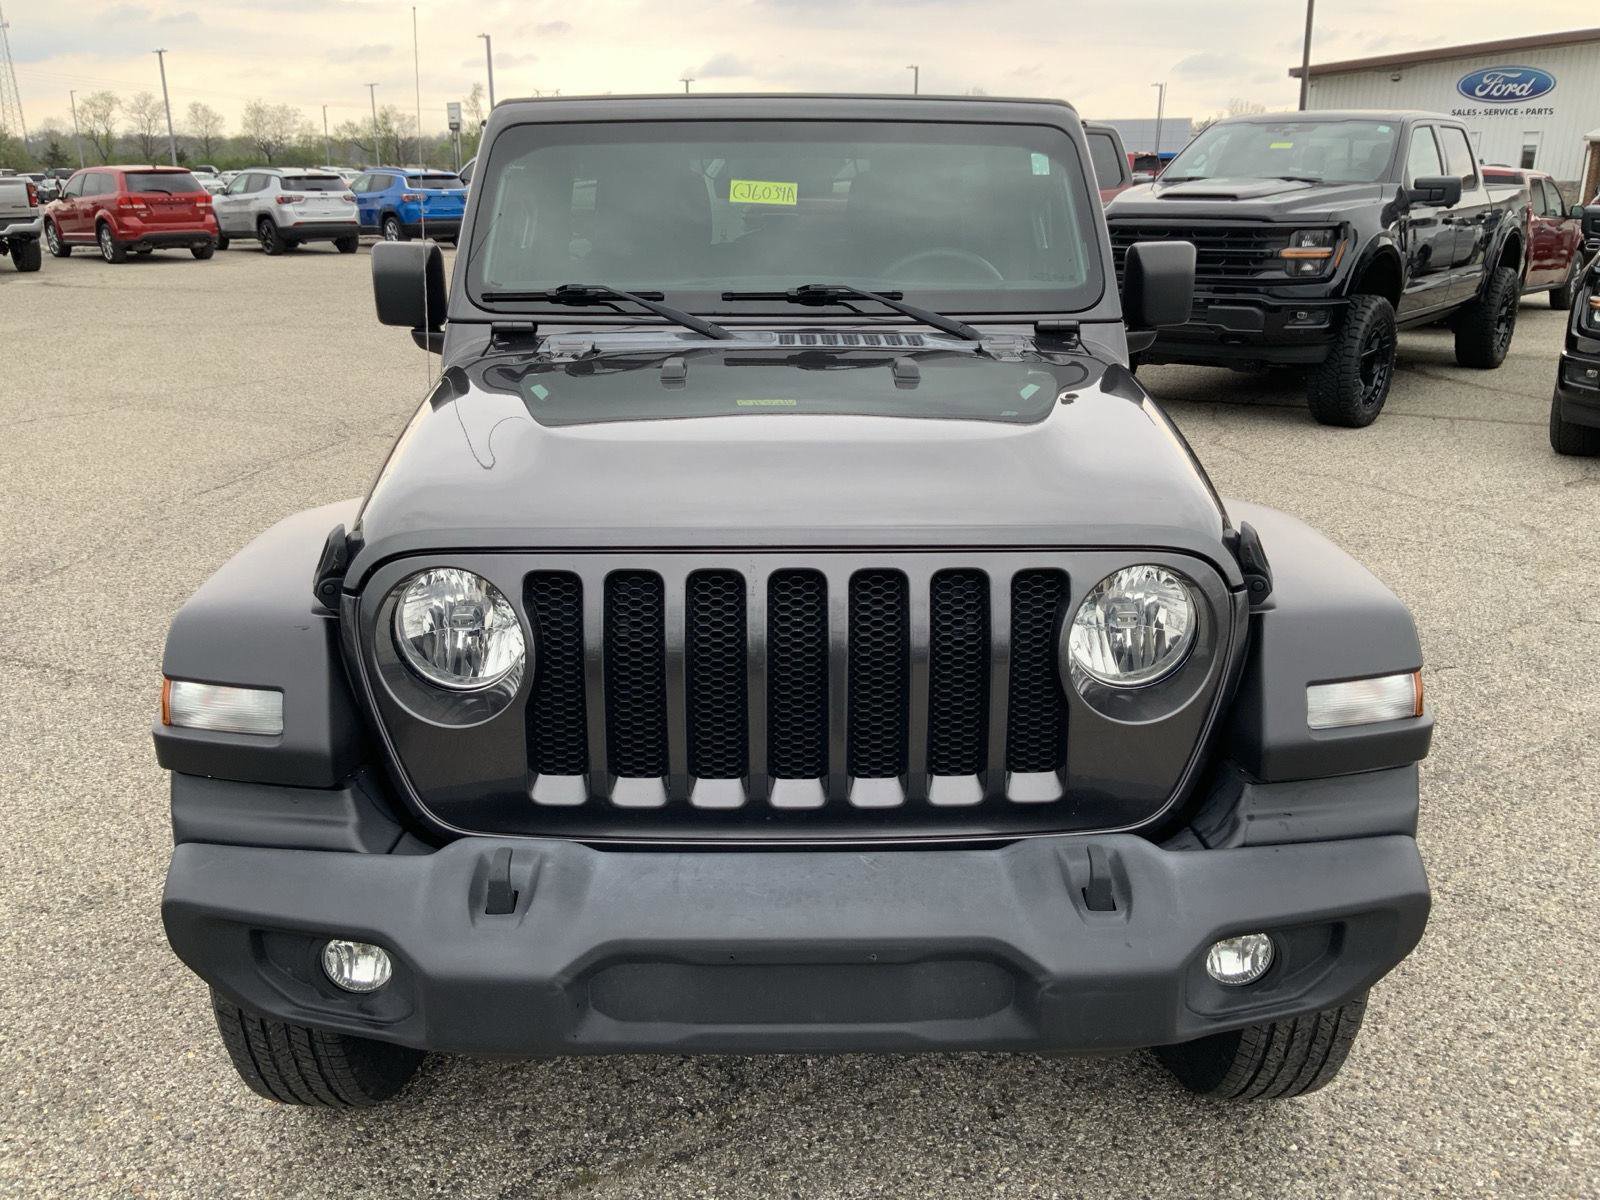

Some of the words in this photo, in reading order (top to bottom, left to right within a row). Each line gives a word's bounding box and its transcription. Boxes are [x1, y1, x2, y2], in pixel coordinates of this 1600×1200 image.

[1475, 72, 1536, 97] Ford
[1451, 108, 1477, 116] SALES
[1483, 108, 1519, 116] SERVICE
[1525, 107, 1554, 115] PARTS
